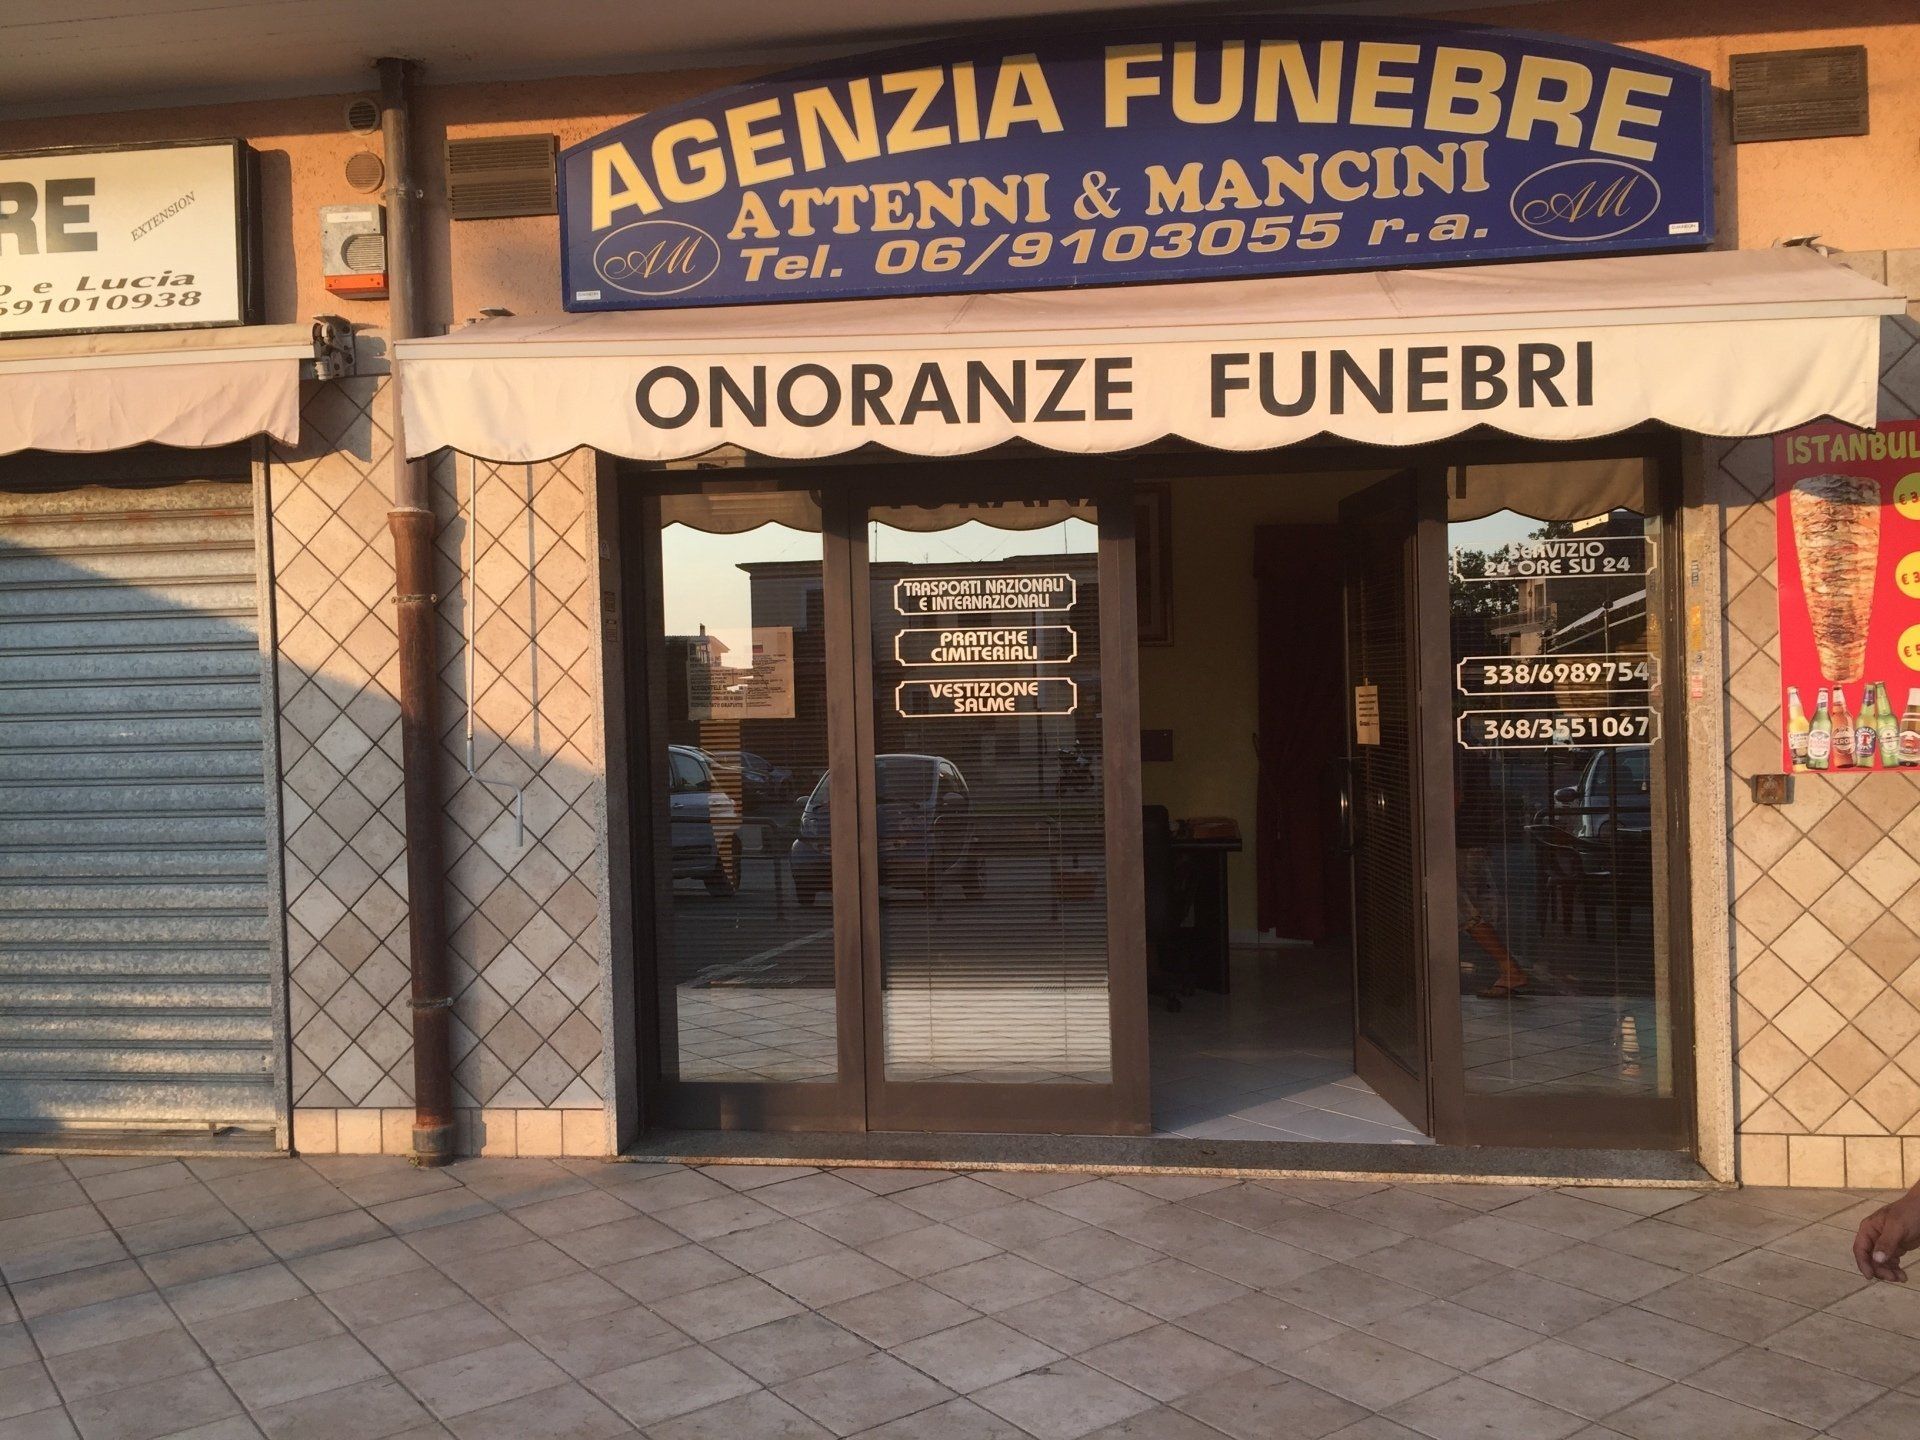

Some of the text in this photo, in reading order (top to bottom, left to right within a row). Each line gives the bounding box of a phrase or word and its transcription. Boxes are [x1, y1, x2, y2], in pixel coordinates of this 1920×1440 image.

[591, 40, 1673, 231] AGENZIA FUNEBRE
[727, 140, 1490, 240] ATTENNI & MANCINI
[0, 177, 98, 256] RE
[130, 191, 197, 242] EXTENSION
[739, 211, 1489, 282] Tel. 06/9103055 r.a.
[33, 282, 53, 294] e
[76, 270, 196, 292] Lucia
[635, 341, 1593, 430] ONORANZE FUNEBRI
[1786, 430, 1920, 465] ISTANBUL
[1509, 541, 1605, 560] SERVIZIO
[1484, 556, 1631, 577] 24 ORE SU 24
[904, 577, 1064, 596] TRASPORTI NAZIONALI
[919, 594, 1050, 611] E INTERNAZIONALI
[940, 630, 1028, 646] PRATICHE
[931, 646, 1038, 662] CIMITERIALI
[1483, 661, 1650, 686] 338/6989754
[929, 682, 1039, 698] VESTIZIONE
[953, 698, 1016, 713] SALME
[1483, 716, 1650, 740] 368/3551067
